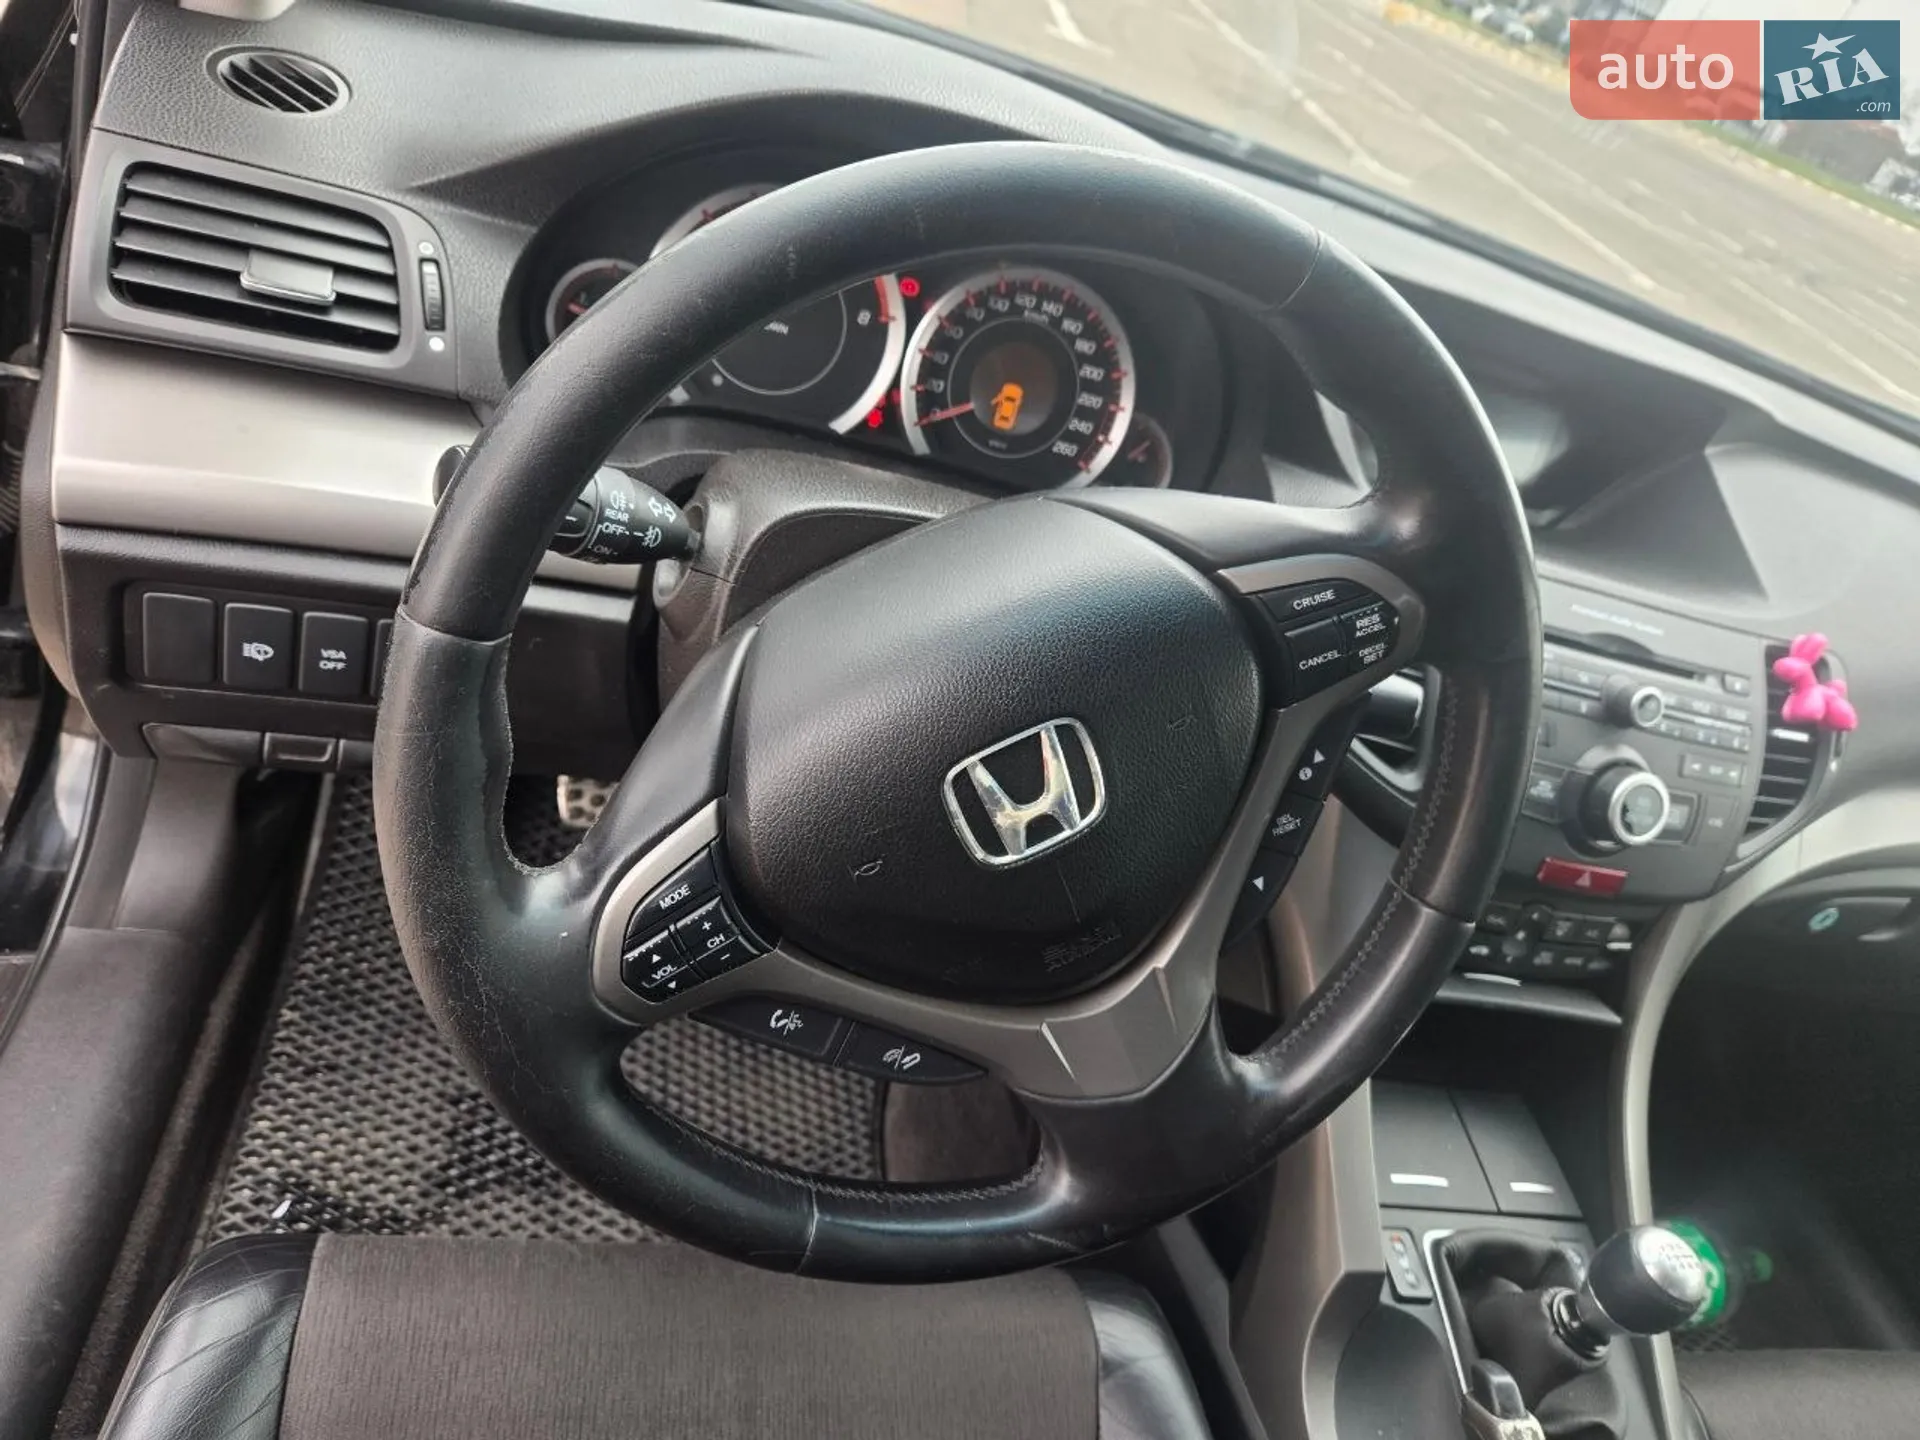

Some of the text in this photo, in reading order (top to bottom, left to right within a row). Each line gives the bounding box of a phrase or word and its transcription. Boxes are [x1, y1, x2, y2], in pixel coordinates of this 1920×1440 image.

[1079, 363, 1105, 382] 200
[1078, 391, 1103, 410] 220
[1068, 418, 1094, 435] 240
[1052, 440, 1078, 457] 260
[605, 508, 630, 523] REAR
[602, 522, 626, 535] OFF
[1293, 589, 1337, 610] CRUISE
[319, 659, 347, 671] OFF
[1299, 650, 1342, 670] CANCEL
[658, 884, 692, 909] MODE
[706, 933, 726, 949] CH
[652, 964, 677, 980] VOL
